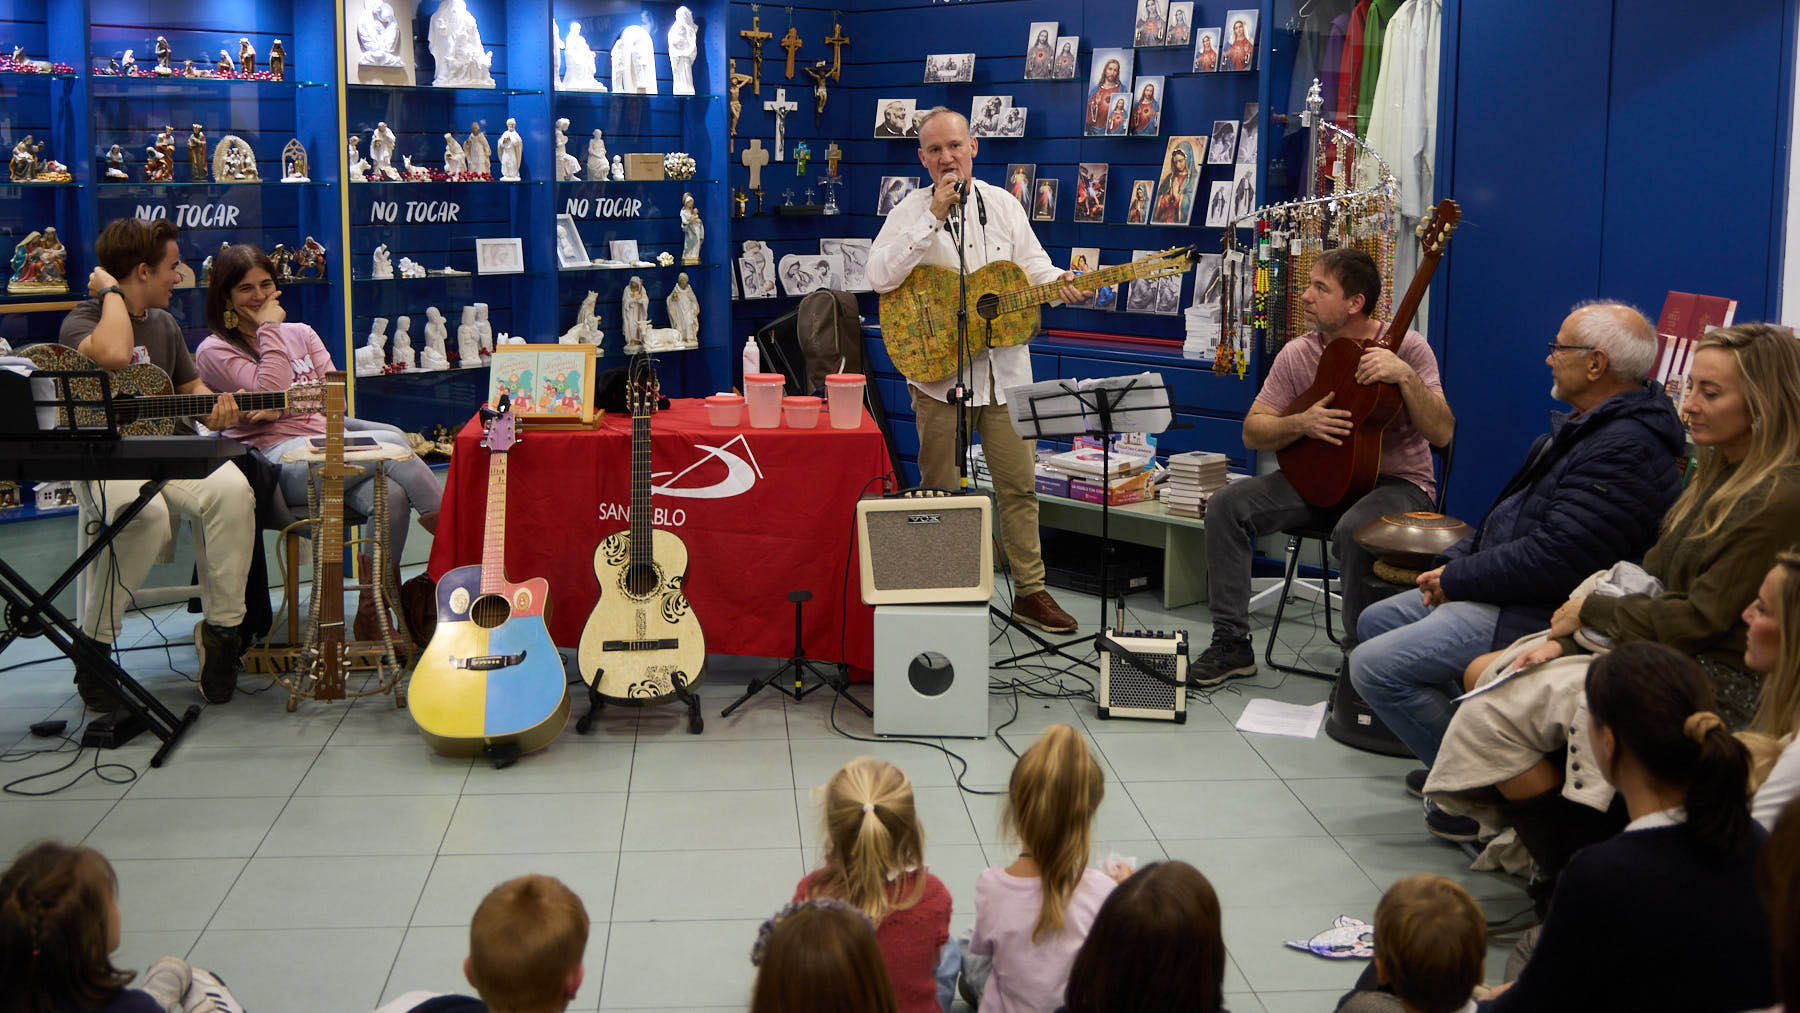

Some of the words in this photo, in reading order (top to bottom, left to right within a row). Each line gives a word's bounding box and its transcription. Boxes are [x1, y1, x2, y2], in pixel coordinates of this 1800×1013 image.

[135, 205, 166, 222] NO
[176, 204, 240, 228] TOCAR
[370, 201, 398, 222] NO
[406, 201, 460, 222] TOCAR
[566, 198, 589, 218] NO
[595, 197, 642, 217] TOCAR
[599, 502, 631, 522] SAN
[652, 507, 686, 526] BLO
[907, 514, 941, 524] VOX
